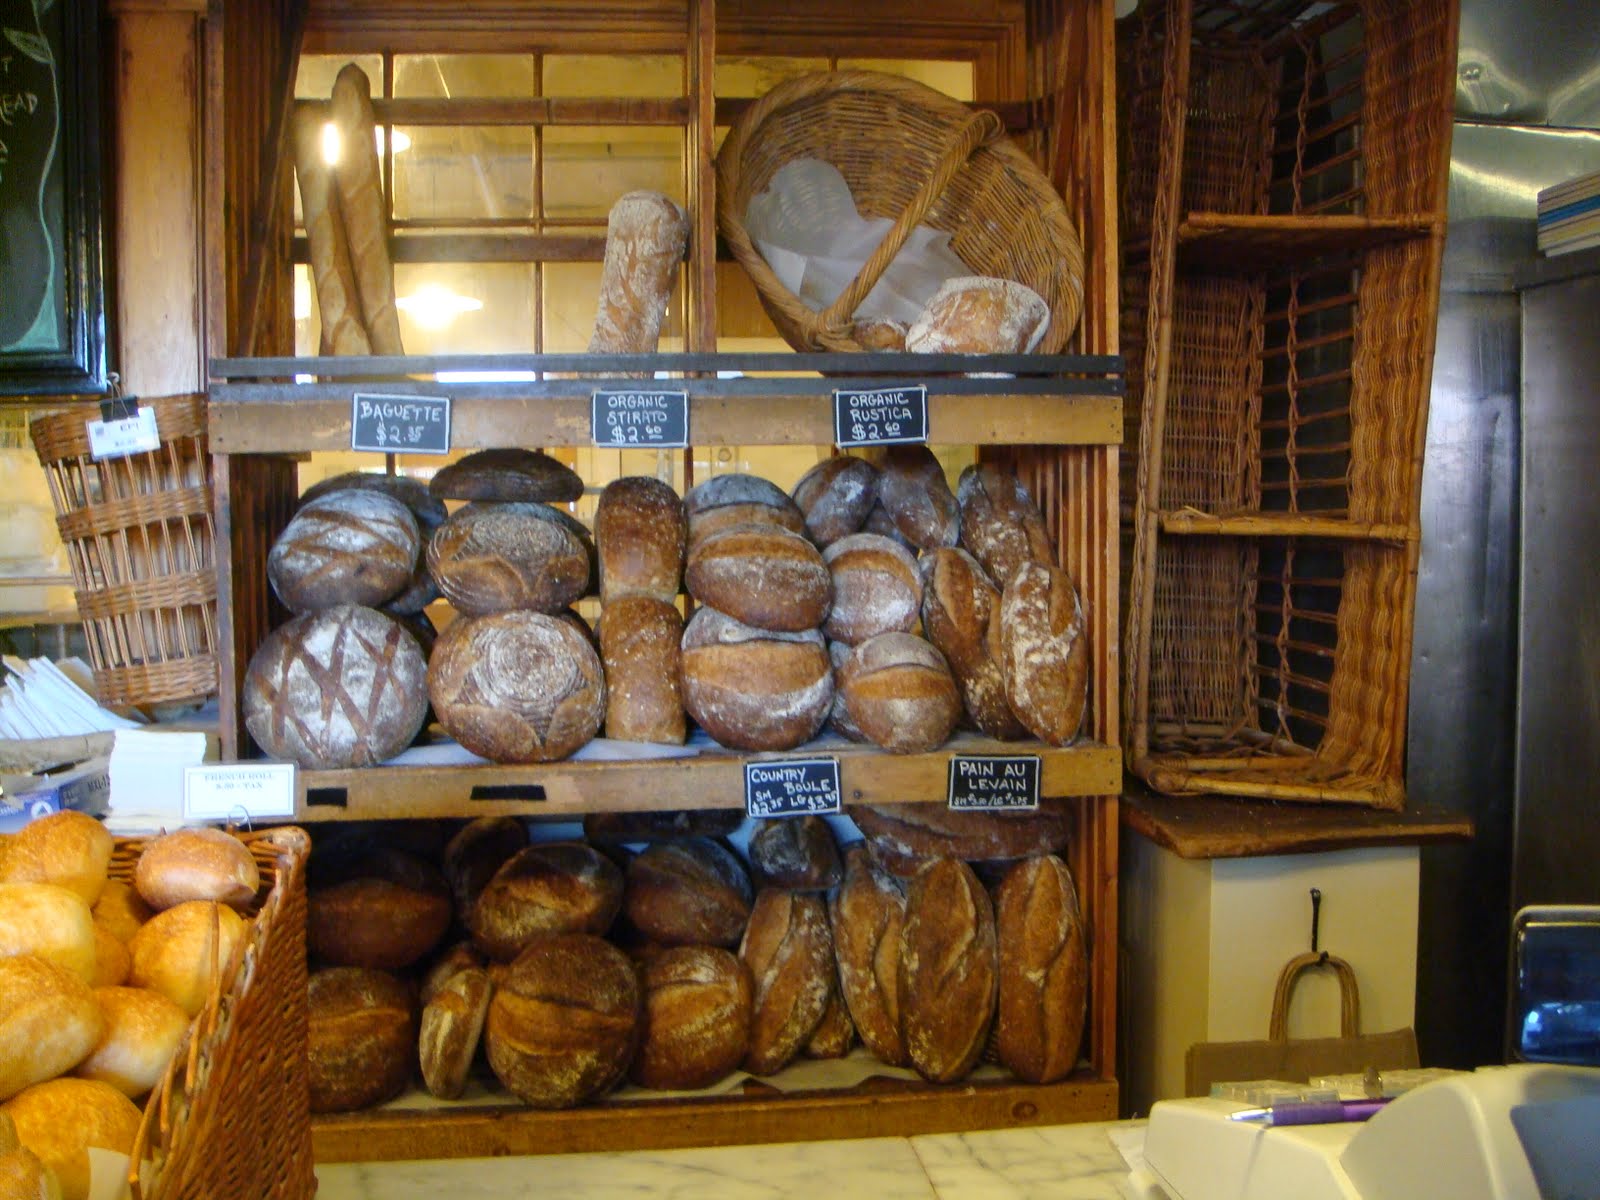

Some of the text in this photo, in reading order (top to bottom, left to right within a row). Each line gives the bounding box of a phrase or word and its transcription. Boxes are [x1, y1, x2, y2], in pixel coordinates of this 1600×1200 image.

[608, 395, 668, 409] ORGANIC
[850, 393, 909, 407] ORGANIC
[361, 401, 442, 422] BAGUETTE
[607, 410, 667, 425] STIRATO
[850, 407, 912, 423] RUSTICA
[751, 767, 806, 783] COUNTRY
[960, 761, 1026, 776] PAIN AU
[783, 779, 831, 795] BOULE
[969, 778, 1026, 791] LEVAIN
[756, 789, 772, 802] SM
